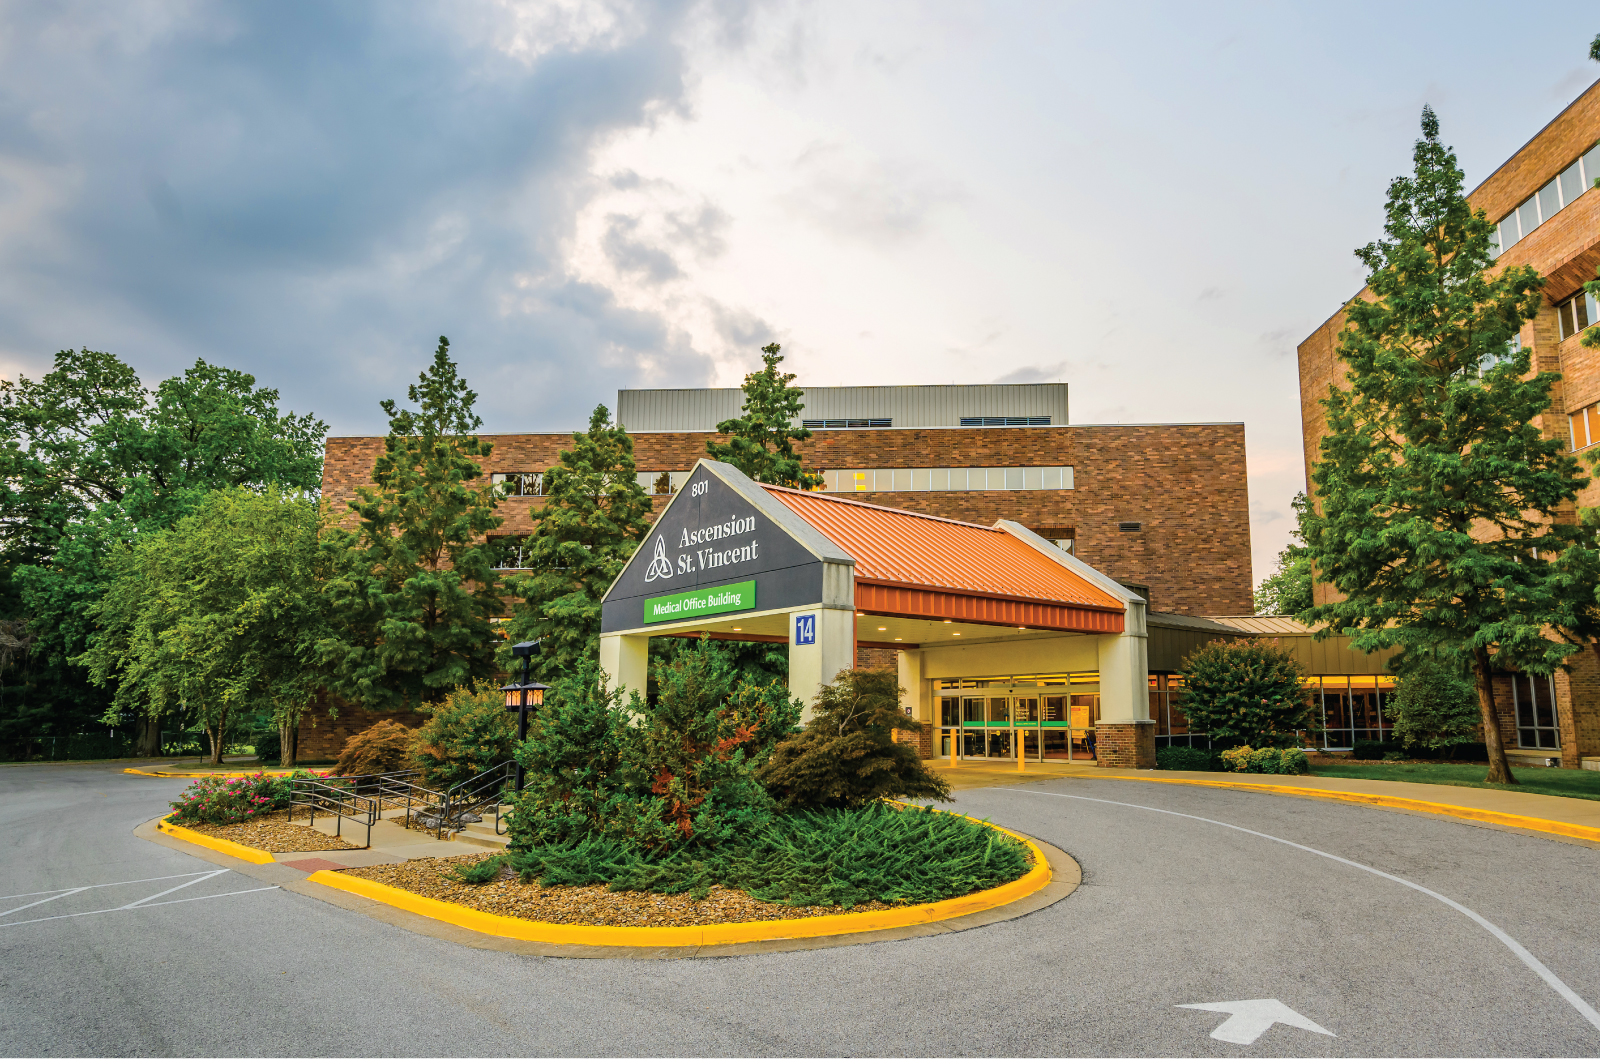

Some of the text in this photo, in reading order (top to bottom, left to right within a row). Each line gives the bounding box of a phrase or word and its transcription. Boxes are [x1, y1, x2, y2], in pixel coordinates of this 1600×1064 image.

[691, 479, 709, 498] 801
[678, 514, 756, 548] Ascension
[677, 540, 759, 575] St. Vincent
[653, 592, 742, 615] Medical Office Building
[797, 617, 814, 642] 14
